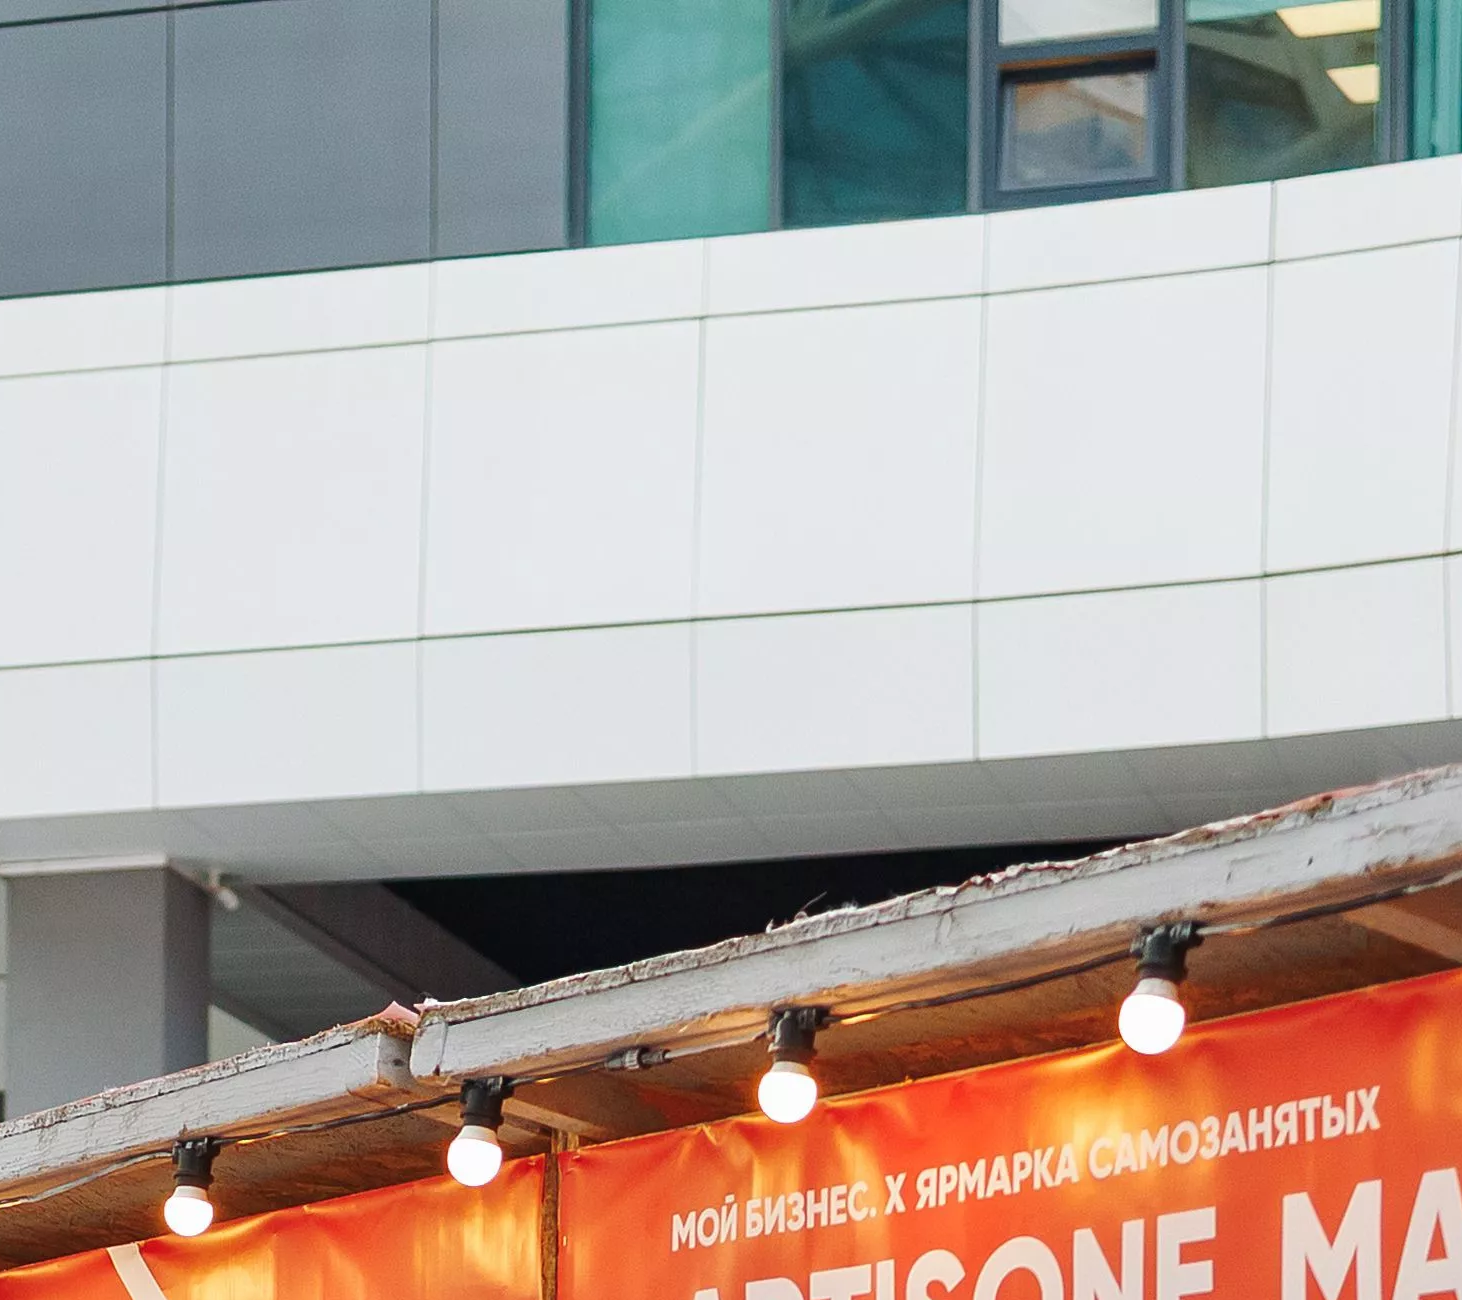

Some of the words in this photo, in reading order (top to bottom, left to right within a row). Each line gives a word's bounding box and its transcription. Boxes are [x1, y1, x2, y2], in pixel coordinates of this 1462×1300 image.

[671, 1196, 739, 1252] МОЙ
[744, 1178, 876, 1236] БИЗНЕС.
[915, 1146, 1080, 1212] ЯРМАРКА
[1089, 1086, 1381, 1182] САМОЗАНЯТЫХ
